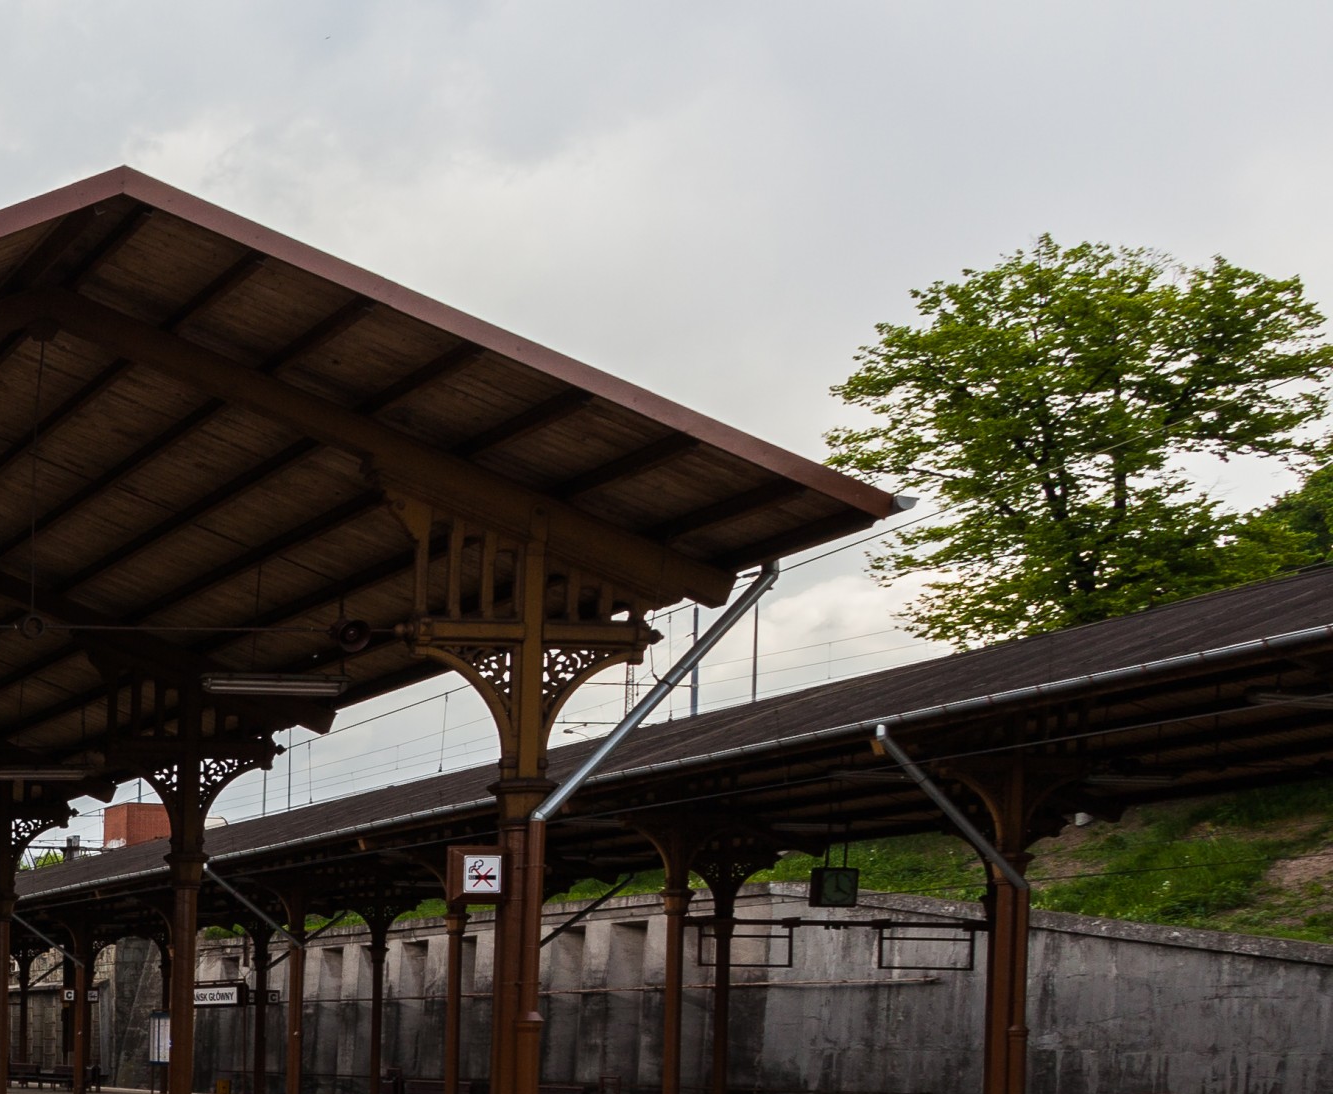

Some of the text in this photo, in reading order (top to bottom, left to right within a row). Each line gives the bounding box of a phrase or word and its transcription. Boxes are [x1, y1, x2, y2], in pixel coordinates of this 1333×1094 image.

[66, 990, 72, 998] C
[208, 990, 234, 1001] GŁÓWNY
[270, 993, 277, 1001] C
